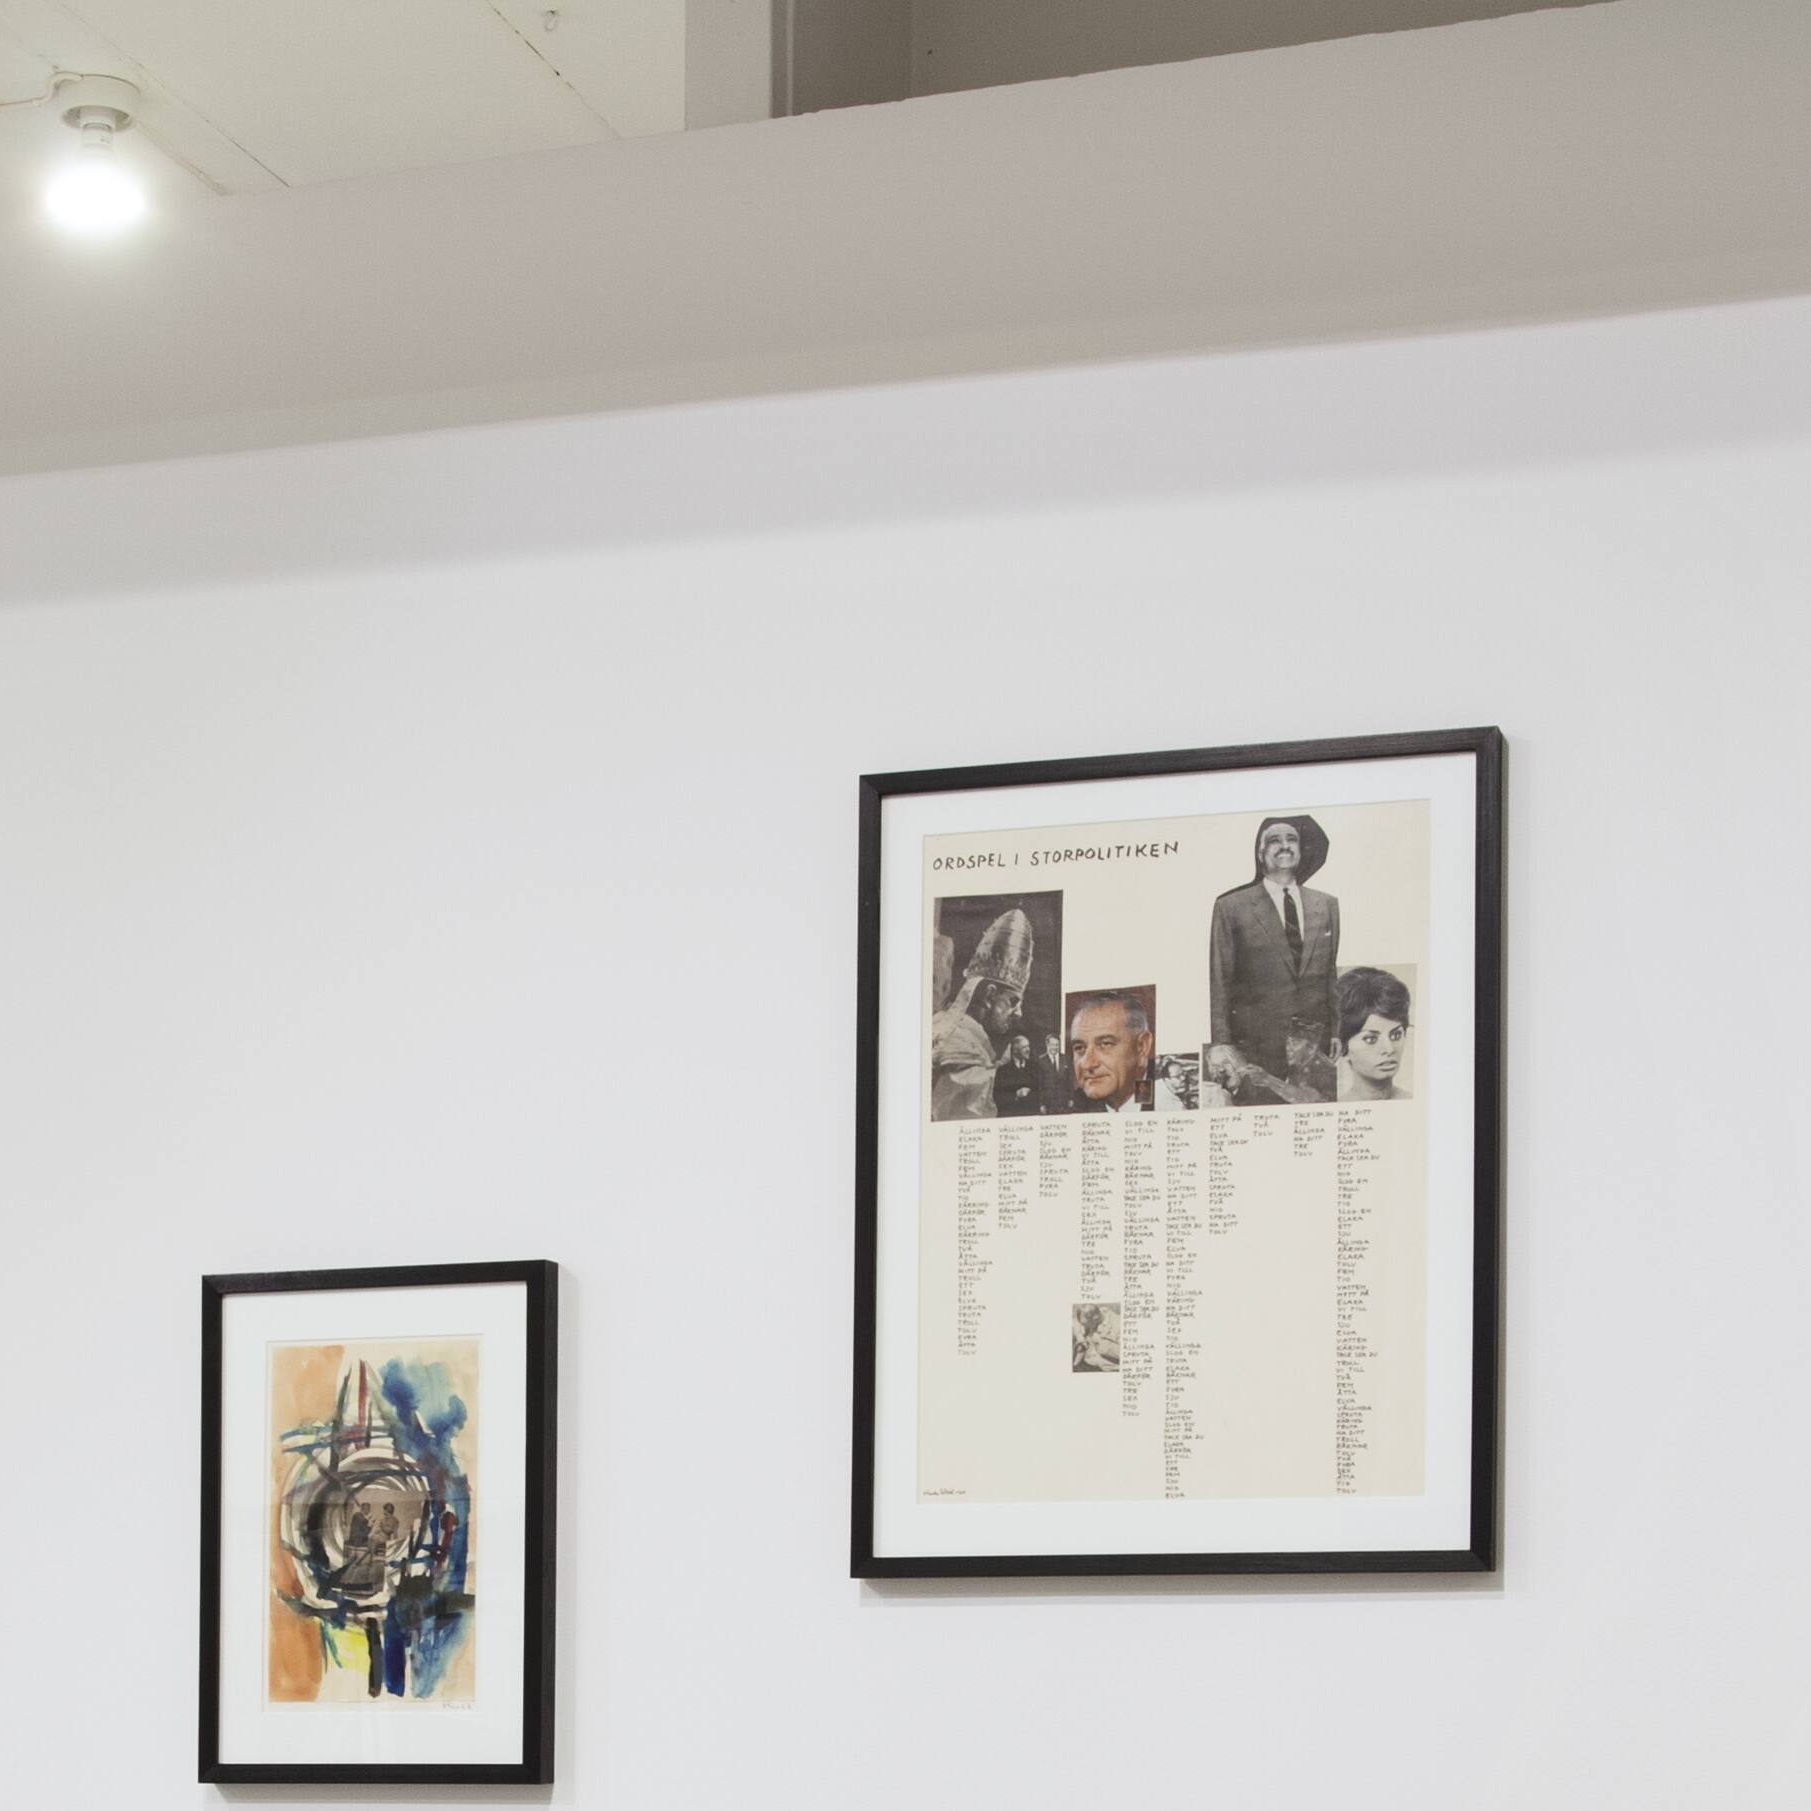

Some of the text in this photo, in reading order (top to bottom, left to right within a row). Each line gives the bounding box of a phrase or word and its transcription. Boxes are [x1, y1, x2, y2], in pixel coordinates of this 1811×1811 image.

[933, 841, 1179, 871] ORDSPEL I STORPOLITIKEN
